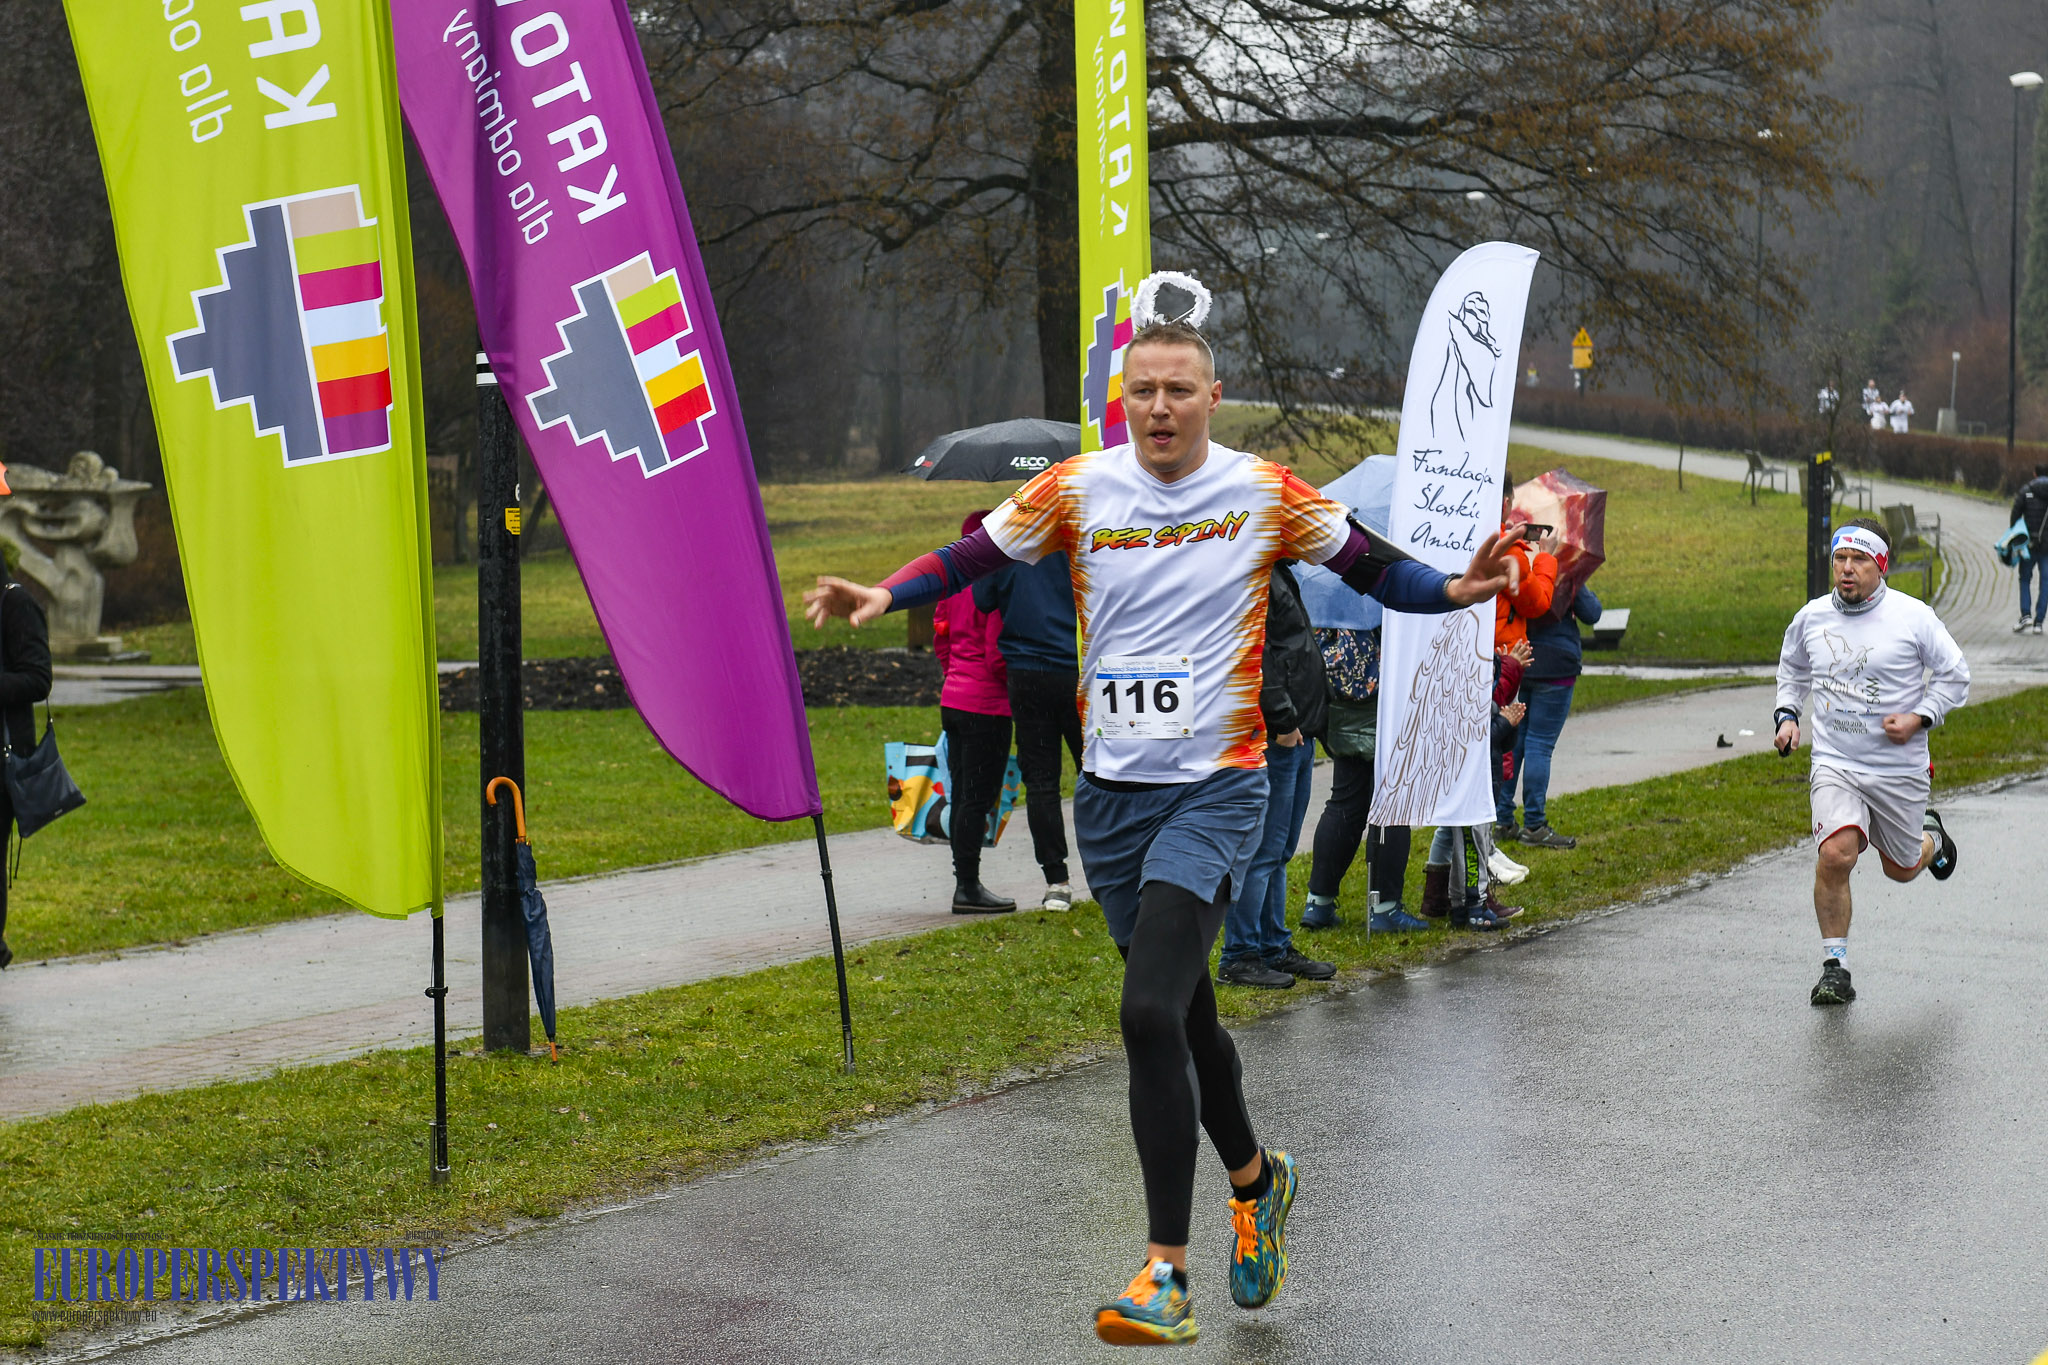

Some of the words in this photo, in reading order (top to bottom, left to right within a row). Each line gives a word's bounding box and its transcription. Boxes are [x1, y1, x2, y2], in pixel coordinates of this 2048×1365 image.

[1090, 527, 1152, 553] BEZ
[1153, 510, 1250, 548] SPINY
[1102, 680, 1179, 713] 116
[1866, 677, 1880, 704] 5KM
[1466, 843, 1479, 888] SKATERS
